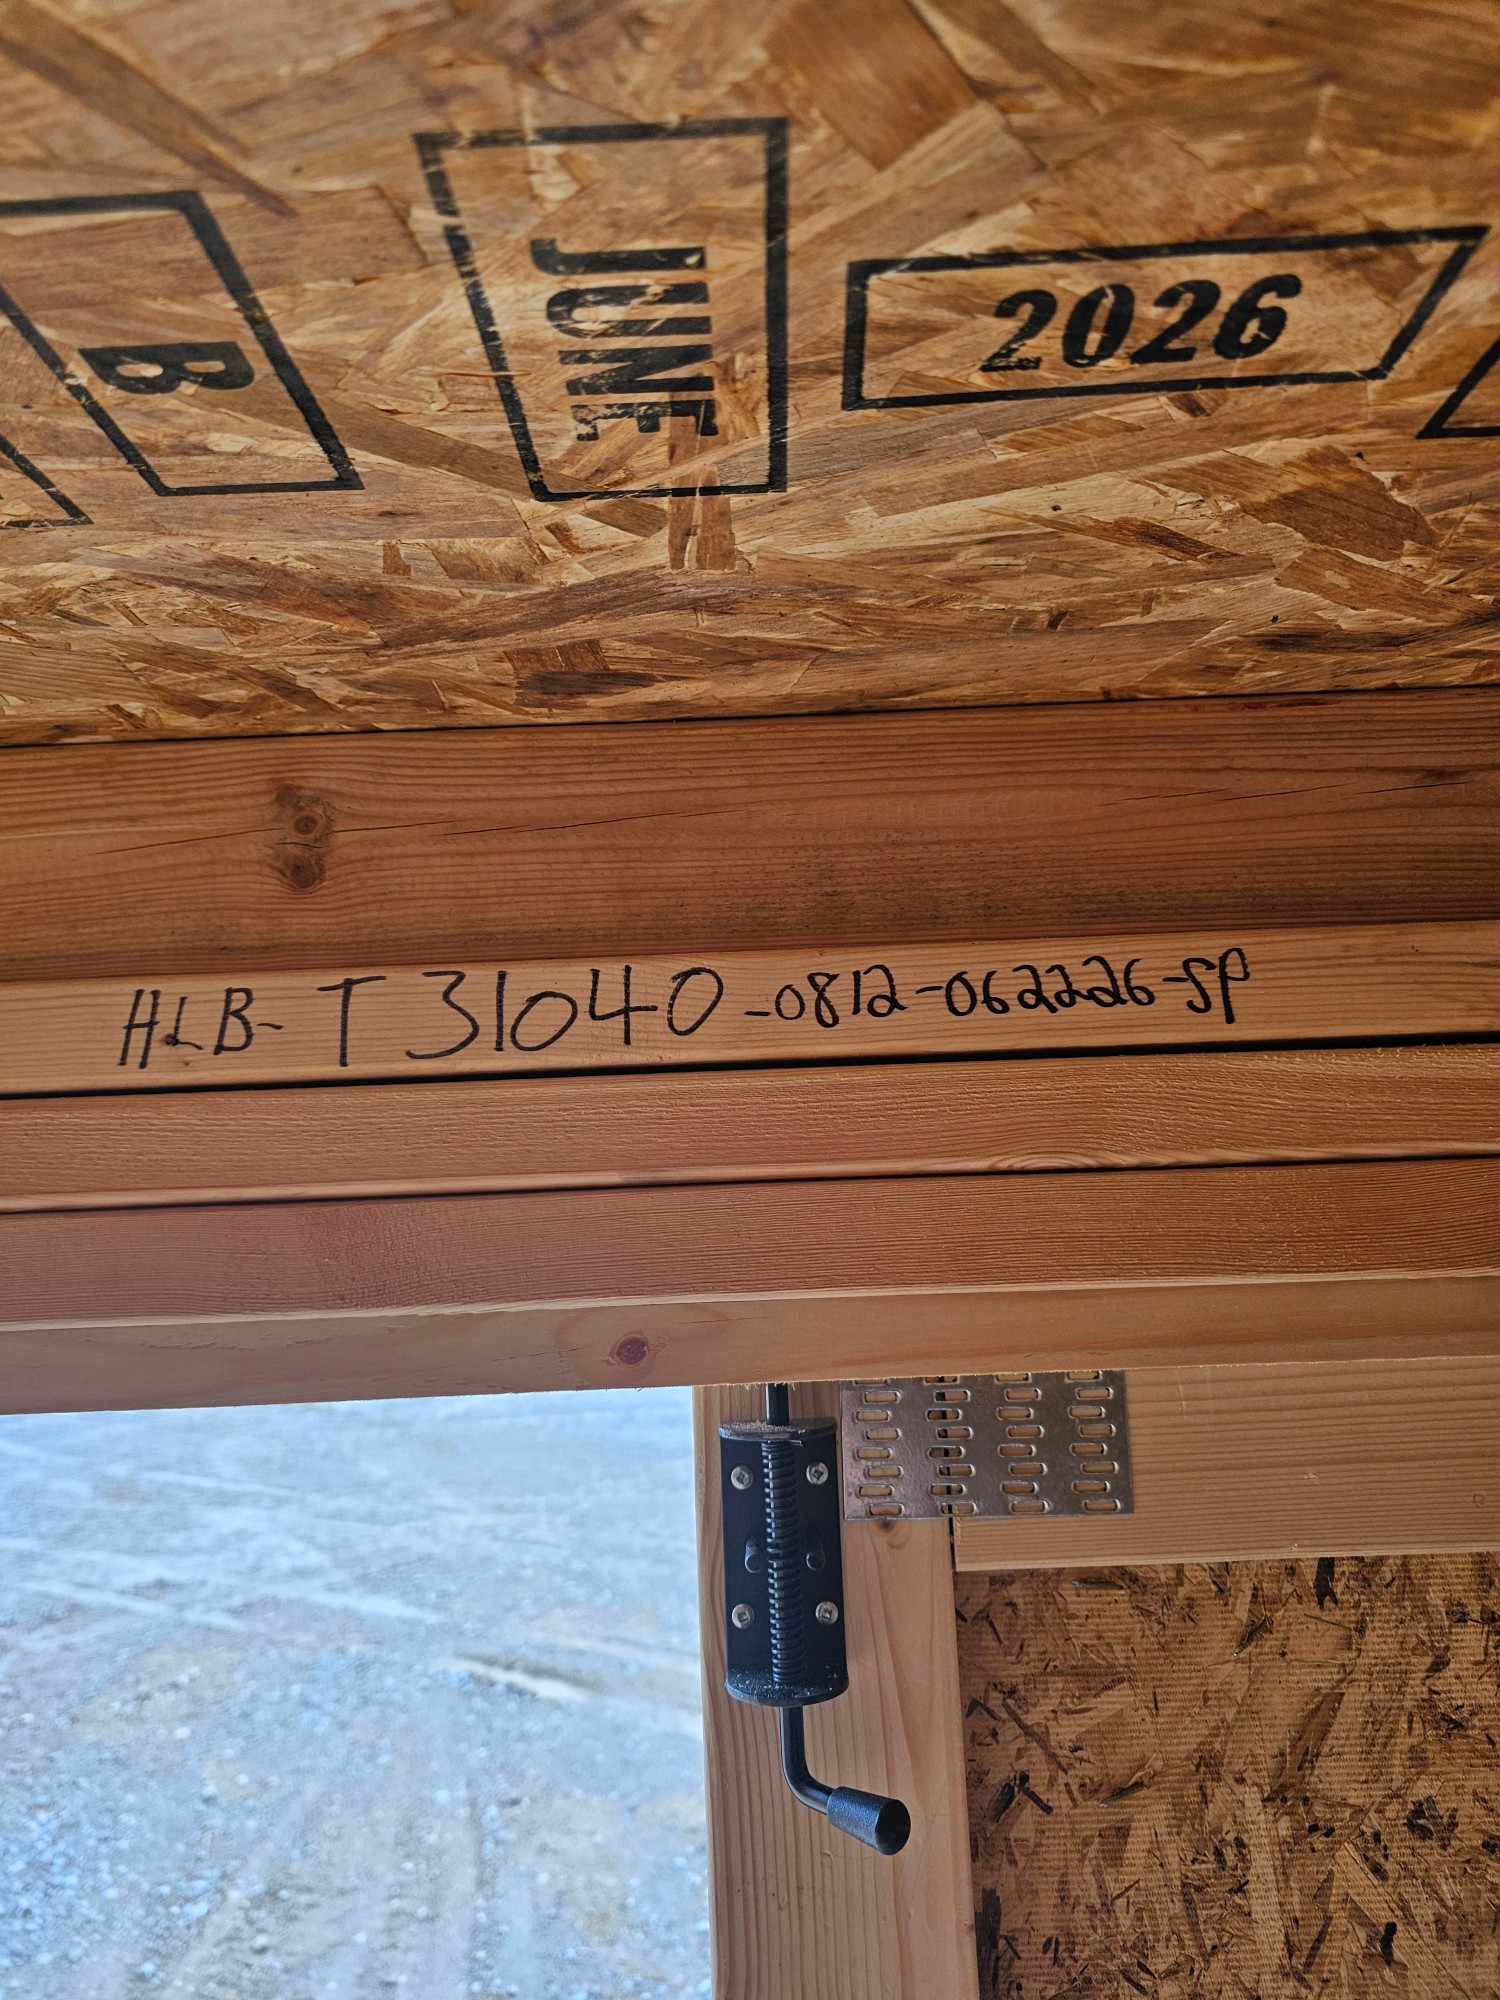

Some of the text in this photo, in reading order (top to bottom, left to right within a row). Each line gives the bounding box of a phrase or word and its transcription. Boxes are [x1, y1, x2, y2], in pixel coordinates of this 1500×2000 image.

[79, 340, 256, 395] B
[530, 238, 719, 442] JUNE
[980, 274, 1302, 373] 2026
